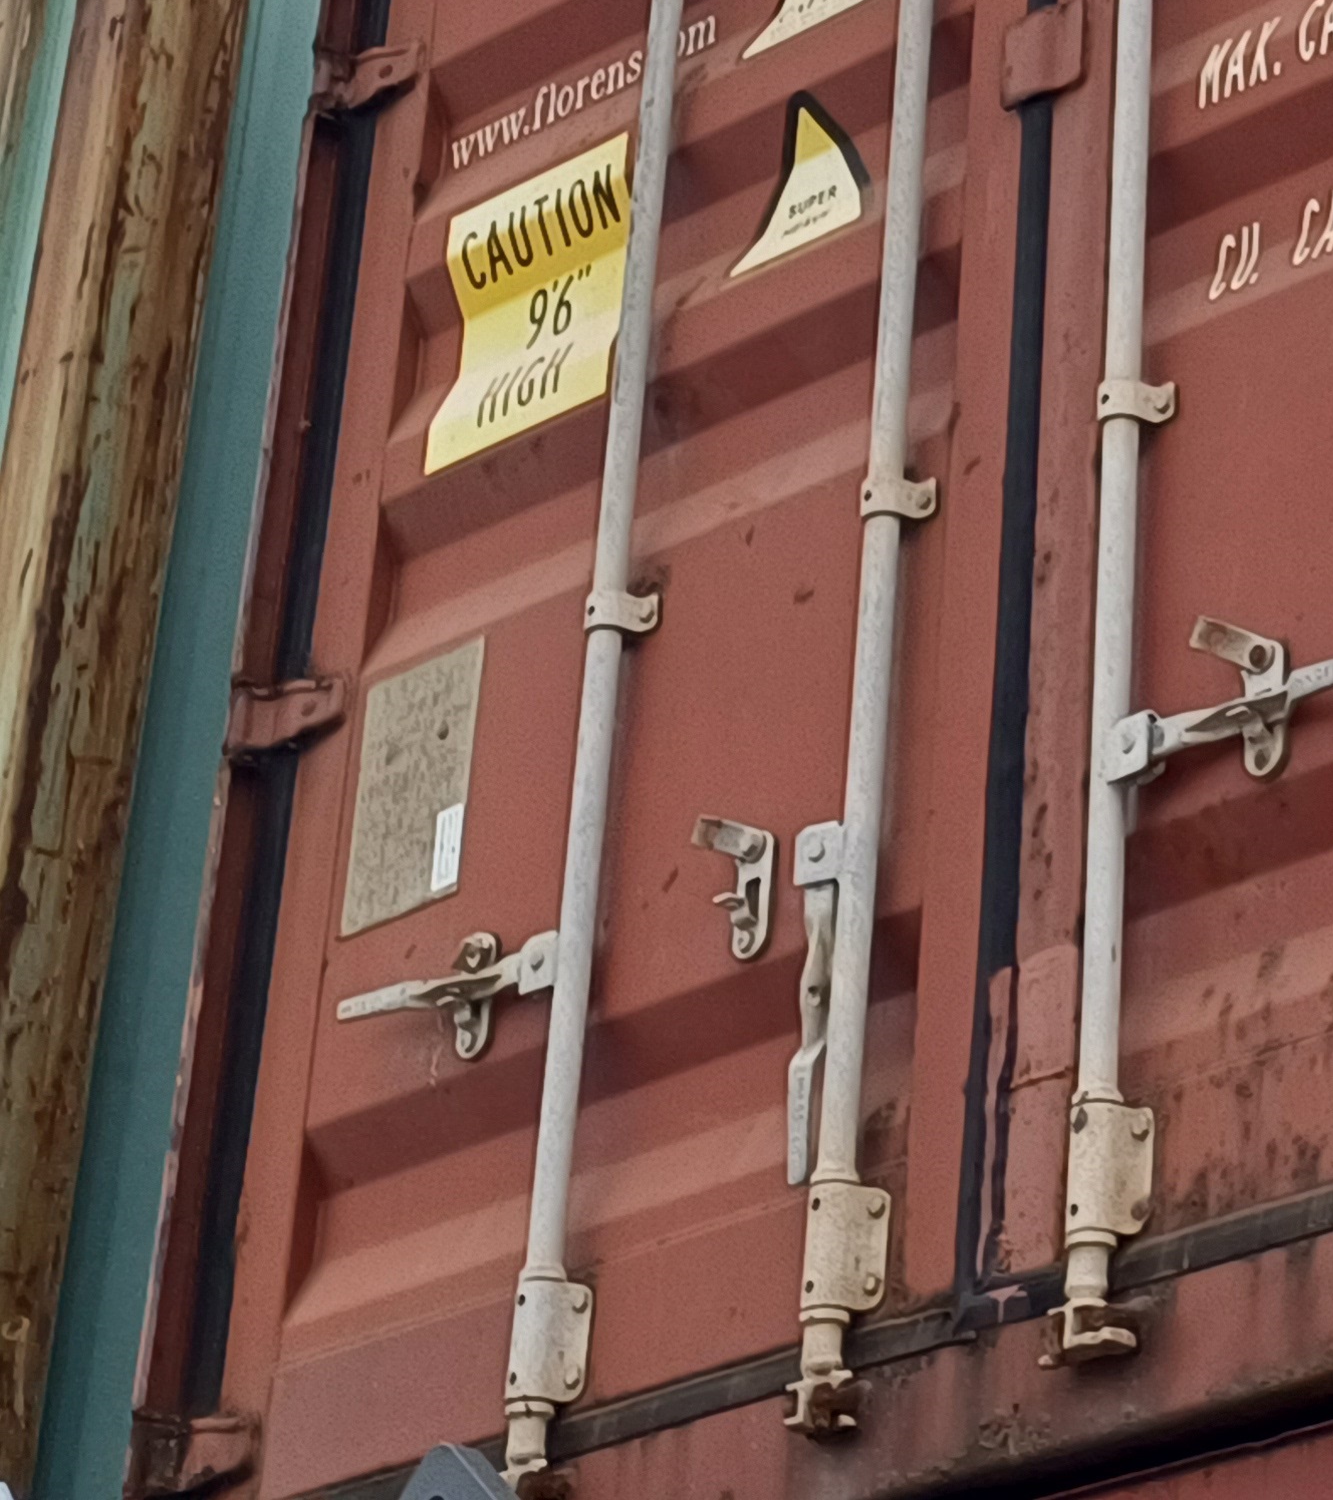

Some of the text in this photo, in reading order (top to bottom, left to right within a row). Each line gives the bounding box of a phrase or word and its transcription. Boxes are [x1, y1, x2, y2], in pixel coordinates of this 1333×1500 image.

[1197, 15, 1282, 109] MAX.
[461, 164, 621, 290] CAUTION
[1209, 222, 1260, 302] CU.
[477, 343, 574, 428] HIGH
